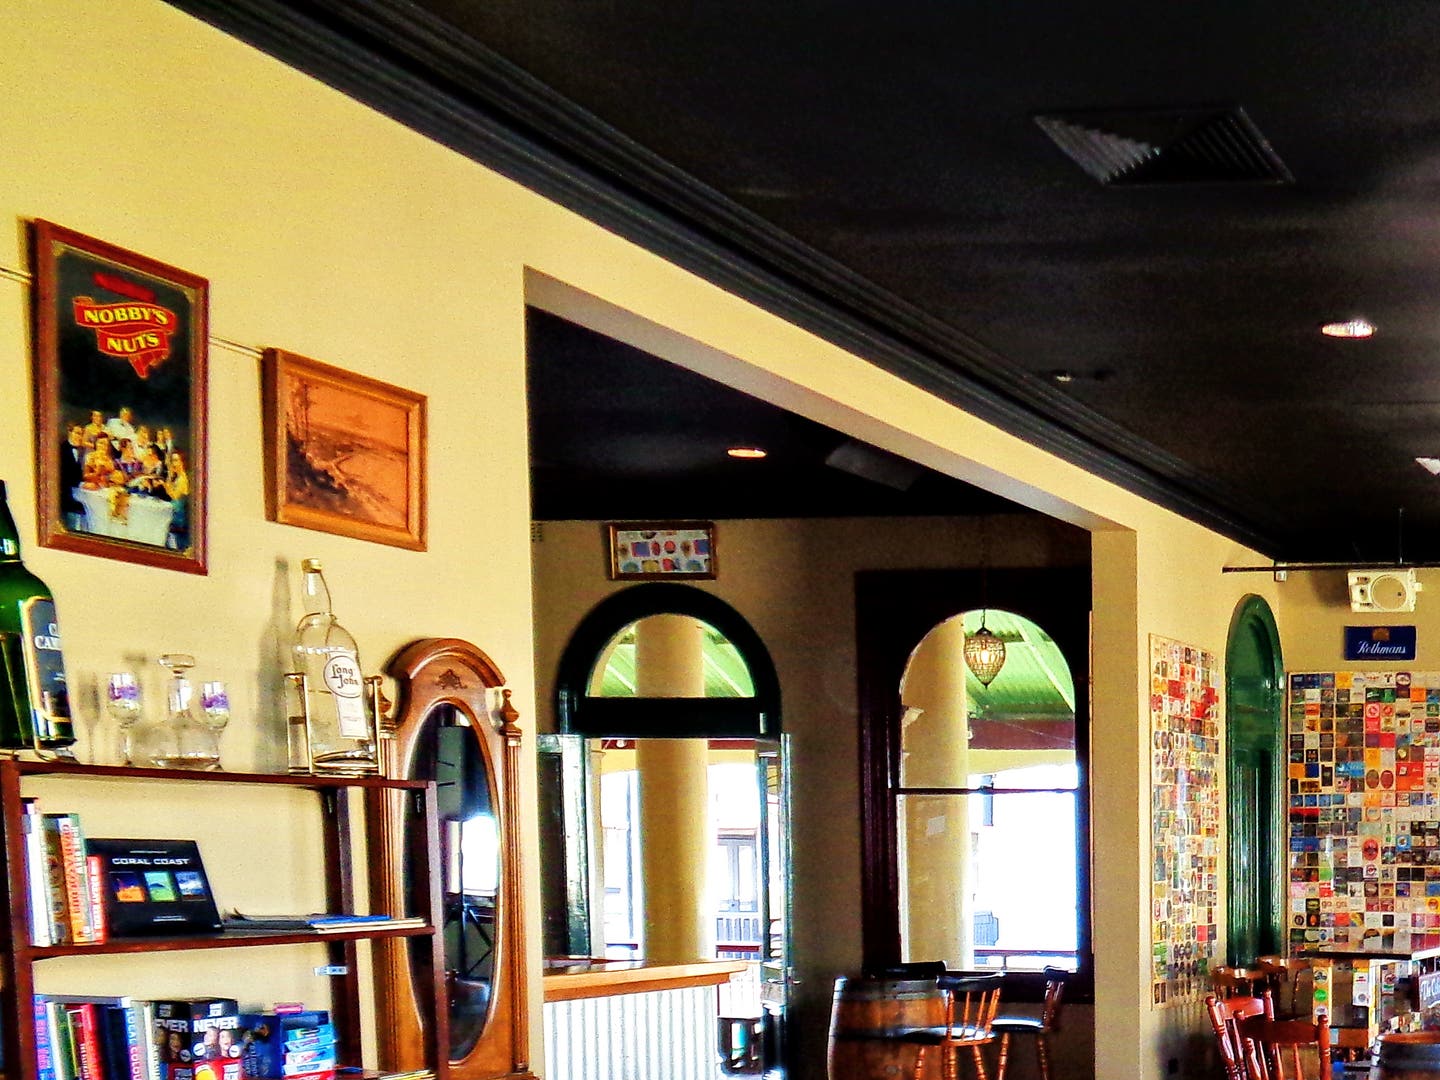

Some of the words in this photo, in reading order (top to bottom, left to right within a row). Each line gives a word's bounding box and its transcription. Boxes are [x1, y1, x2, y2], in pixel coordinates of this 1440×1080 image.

[83, 307, 169, 325] NOBBY'S
[106, 333, 160, 353] NUTS
[1357, 640, 1406, 655] Rothmans
[330, 664, 354, 677] Long
[330, 674, 359, 689] John
[126, 1010, 137, 1043] LOCAL
[154, 1018, 189, 1033] EVER
[193, 1016, 238, 1033] NEVER
